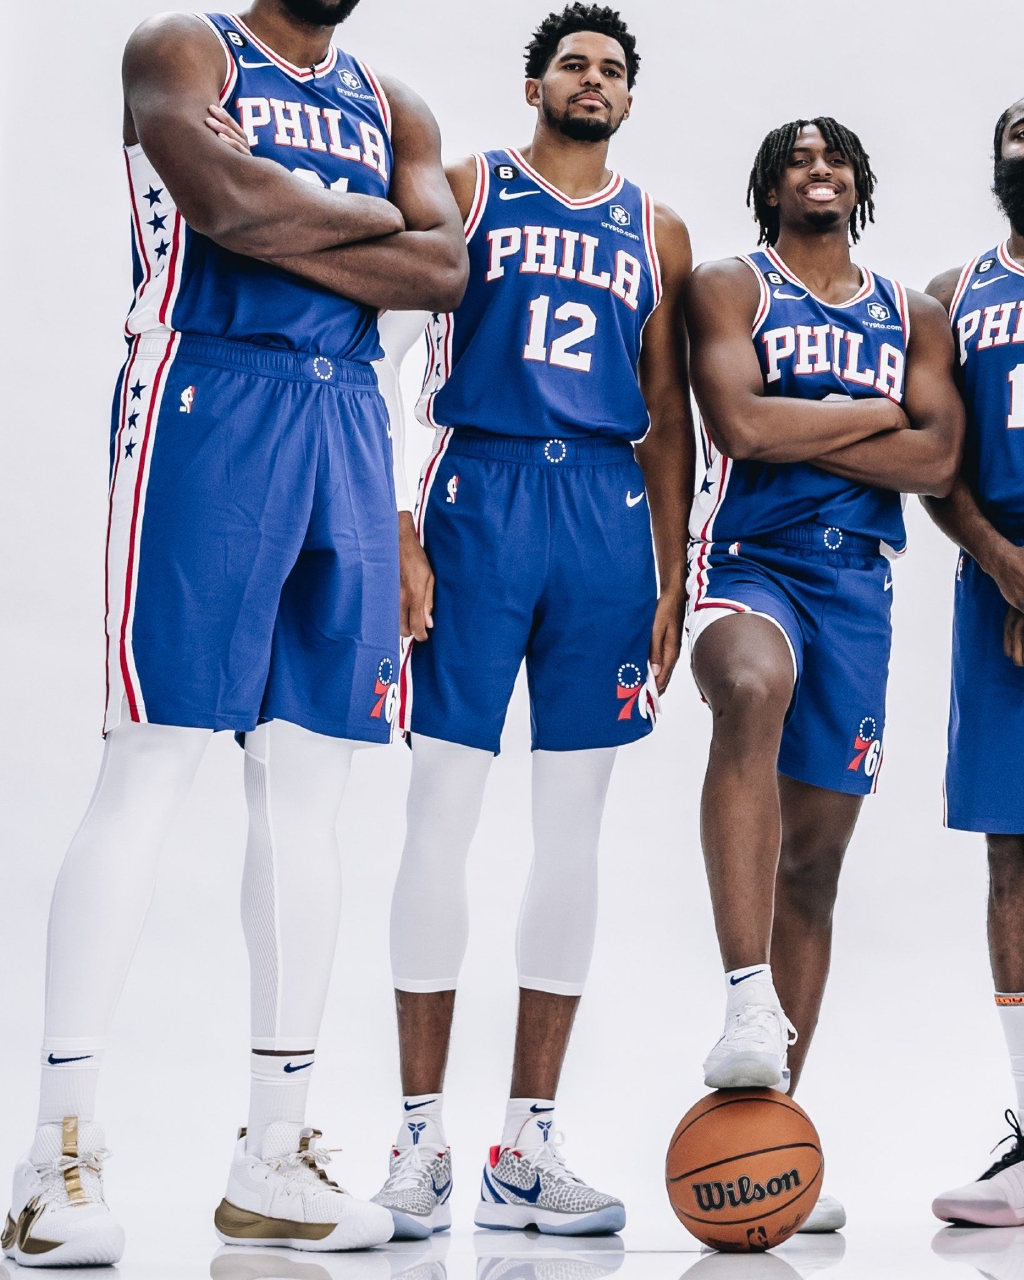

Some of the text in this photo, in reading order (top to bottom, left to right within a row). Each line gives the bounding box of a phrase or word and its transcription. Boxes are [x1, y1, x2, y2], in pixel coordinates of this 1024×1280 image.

[236, 97, 388, 182] PHILA
[499, 166, 513, 179] 6
[601, 221, 640, 241] crypto.com
[486, 225, 642, 311] PHILA
[979, 259, 993, 273] 6
[523, 294, 598, 372] 12
[862, 320, 903, 332] crypto.com
[762, 323, 904, 404] PHILA
[846, 734, 880, 777] 76
[692, 1168, 801, 1212] Wilson
